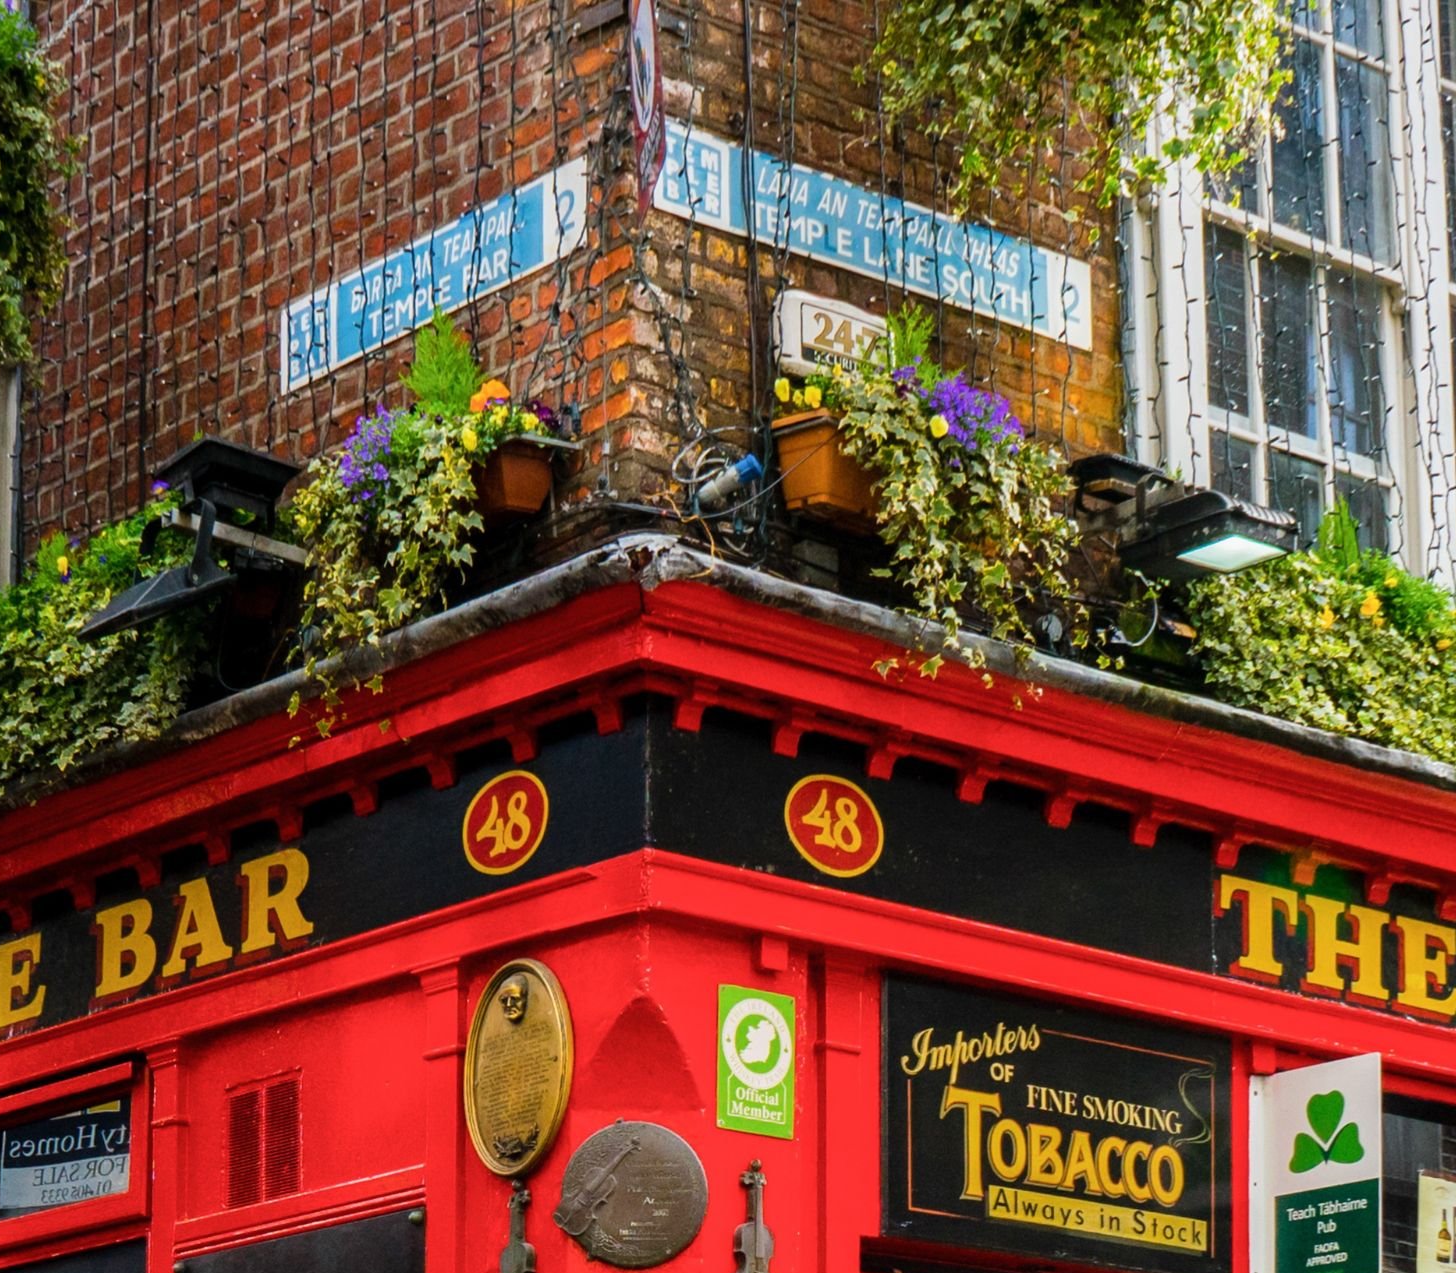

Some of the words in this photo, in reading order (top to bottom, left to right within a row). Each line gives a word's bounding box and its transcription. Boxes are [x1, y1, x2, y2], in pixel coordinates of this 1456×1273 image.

[556, 188, 575, 237] 2
[817, 186, 848, 218] AN
[942, 263, 1030, 317] SOUTH
[476, 790, 531, 858] 48
[802, 788, 862, 853] 48
[93, 847, 316, 1000] BAR
[901, 1022, 1041, 1082] Importers
[990, 1062, 1015, 1085] OF
[731, 1100, 784, 1122] Member
[735, 1086, 780, 1106] Official
[1026, 1084, 1078, 1117] FINE
[1082, 1094, 1184, 1137] SMOKING
[940, 1084, 1185, 1209] TOBACCO
[991, 1187, 1086, 1233] Always
[1099, 1206, 1122, 1232] in
[1131, 1208, 1203, 1248] Stock
[1286, 1204, 1316, 1222] Teach
[1317, 1218, 1337, 1234] Pub
[1305, 1252, 1349, 1267] APPROVED
